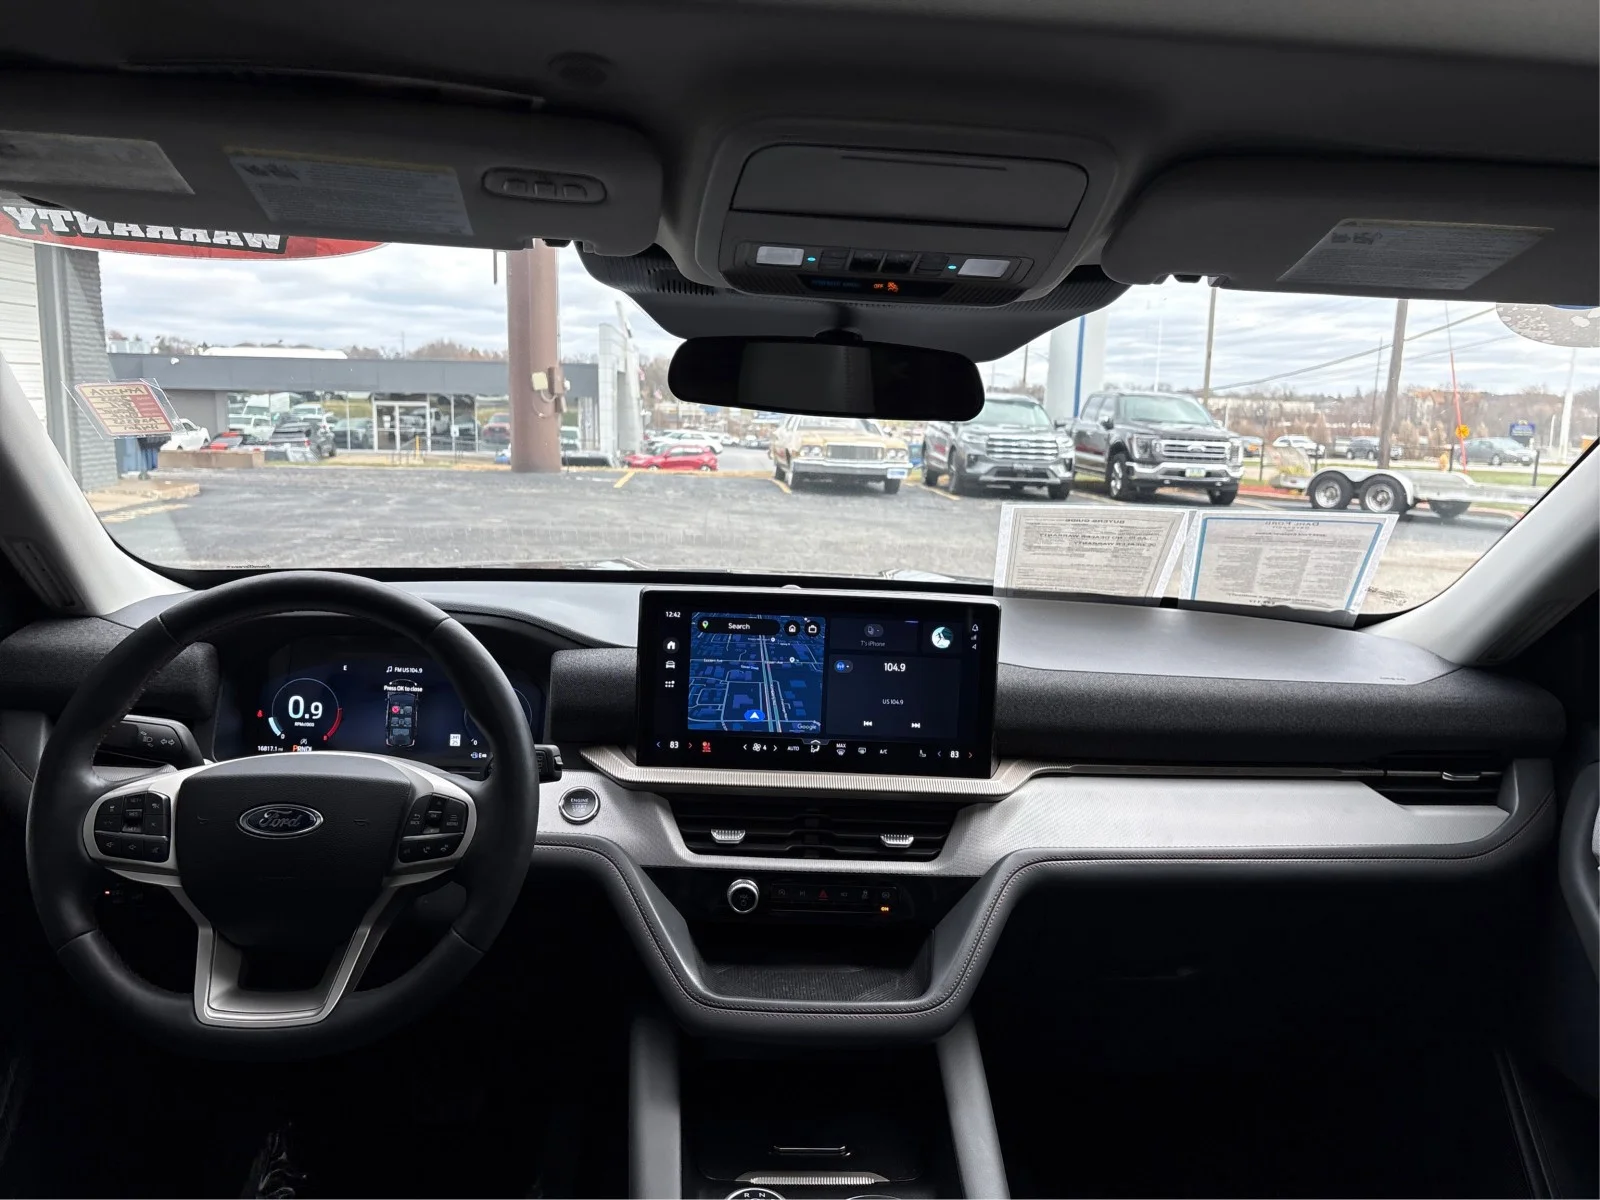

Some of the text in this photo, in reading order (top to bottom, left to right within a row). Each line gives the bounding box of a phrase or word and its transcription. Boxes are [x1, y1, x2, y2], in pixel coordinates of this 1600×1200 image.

[728, 622, 751, 631] Search
[869, 640, 886, 648] iPhone
[883, 662, 906, 672] 104.9
[288, 695, 323, 719] 0.9
[669, 741, 679, 749] 83
[950, 751, 960, 759] 83
[258, 809, 302, 829] Ford
